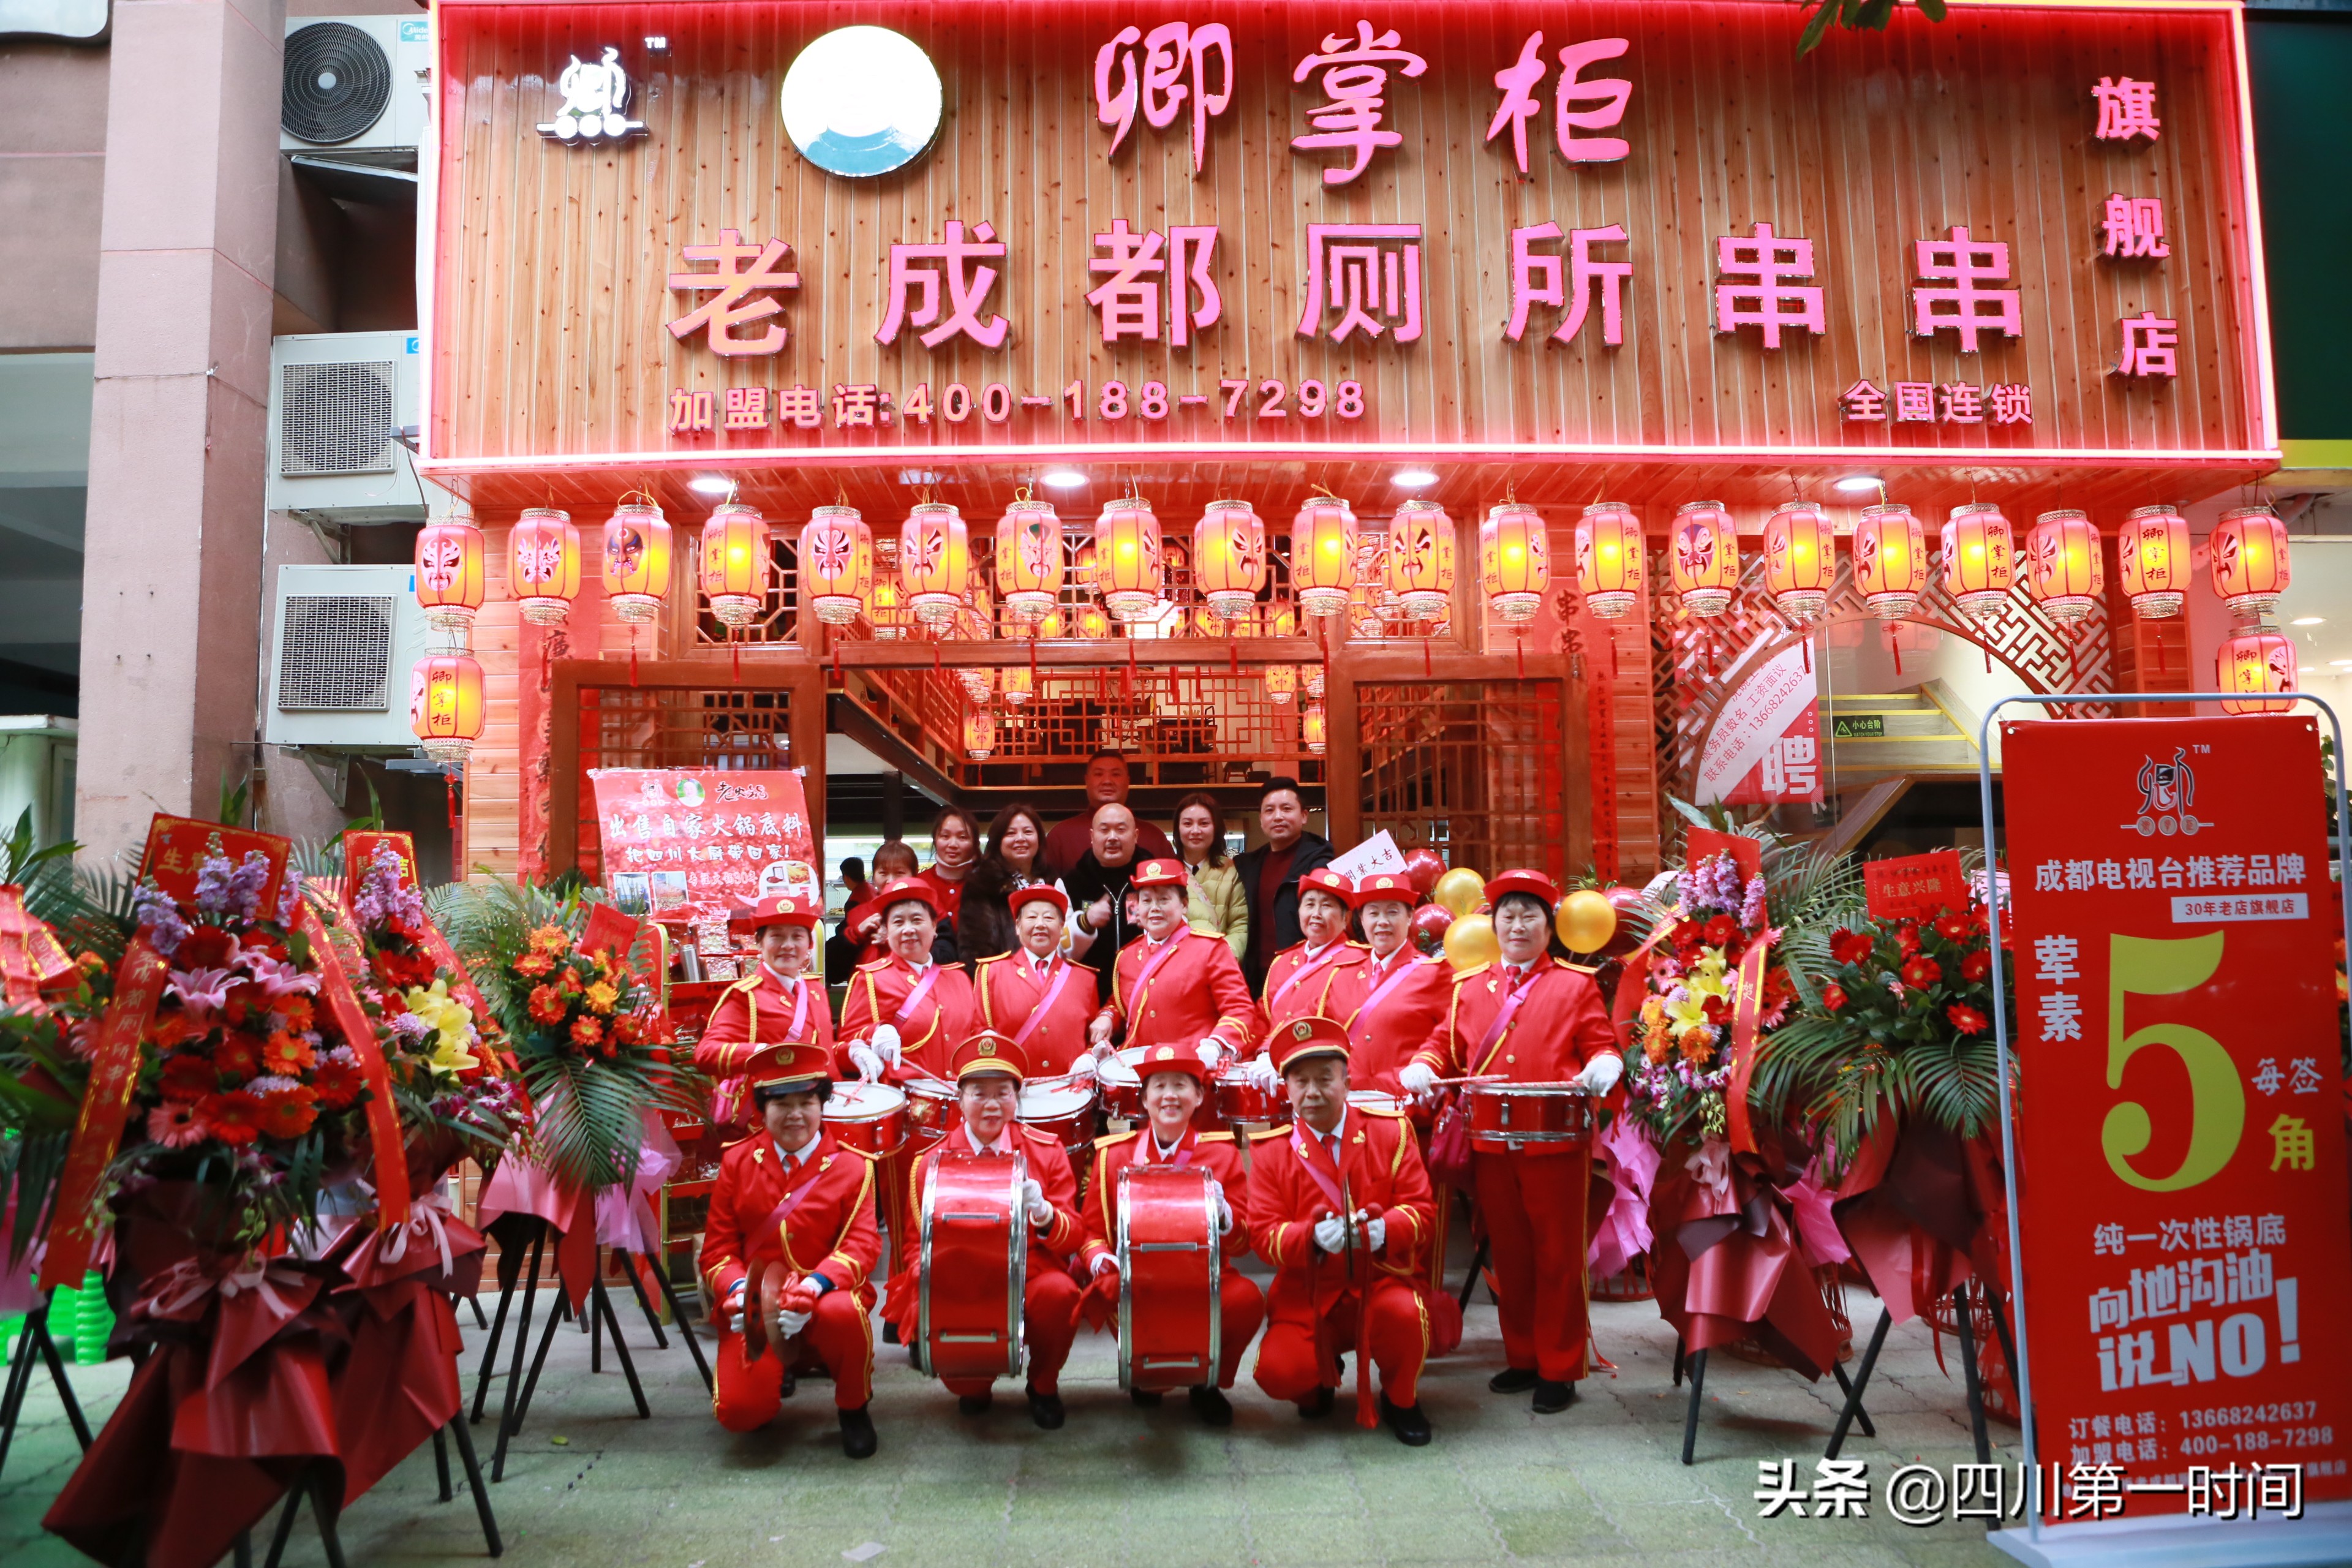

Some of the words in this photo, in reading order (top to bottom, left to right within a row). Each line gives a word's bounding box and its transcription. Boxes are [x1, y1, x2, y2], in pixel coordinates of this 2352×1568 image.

[645, 38, 666, 49] TM
[1094, 19, 1633, 187] 卿掌柜
[2092, 76, 2179, 378] 旗舰店
[666, 219, 2022, 358] 老成都厕所串串
[1841, 379, 2033, 425] 全国连锁
[1988, 526, 2008, 579] 卿掌柜
[2143, 527, 2167, 580] 卿掌柜
[432, 670, 452, 726] 卿掌柜
[1747, 663, 1787, 707] 工资面议
[1852, 720, 1881, 730] 小心台阶
[2193, 744, 2211, 754] TM
[1762, 735, 1817, 796] 聘
[609, 811, 803, 840] 出售自家火锅底料
[1882, 878, 1942, 899] 生意兴隆
[2035, 853, 2307, 892] 成都电视台推荐品牌
[2185, 899, 2294, 916] 30年老店旗舰店
[2034, 935, 2082, 1042] 荤素
[2101, 929, 2245, 1193] 5
[2251, 1057, 2323, 1096] 每签
[2267, 1114, 2315, 1172] 角
[2094, 1213, 2286, 1256] 纯一次性锅底
[2089, 1248, 2274, 1333] 向地沟油
